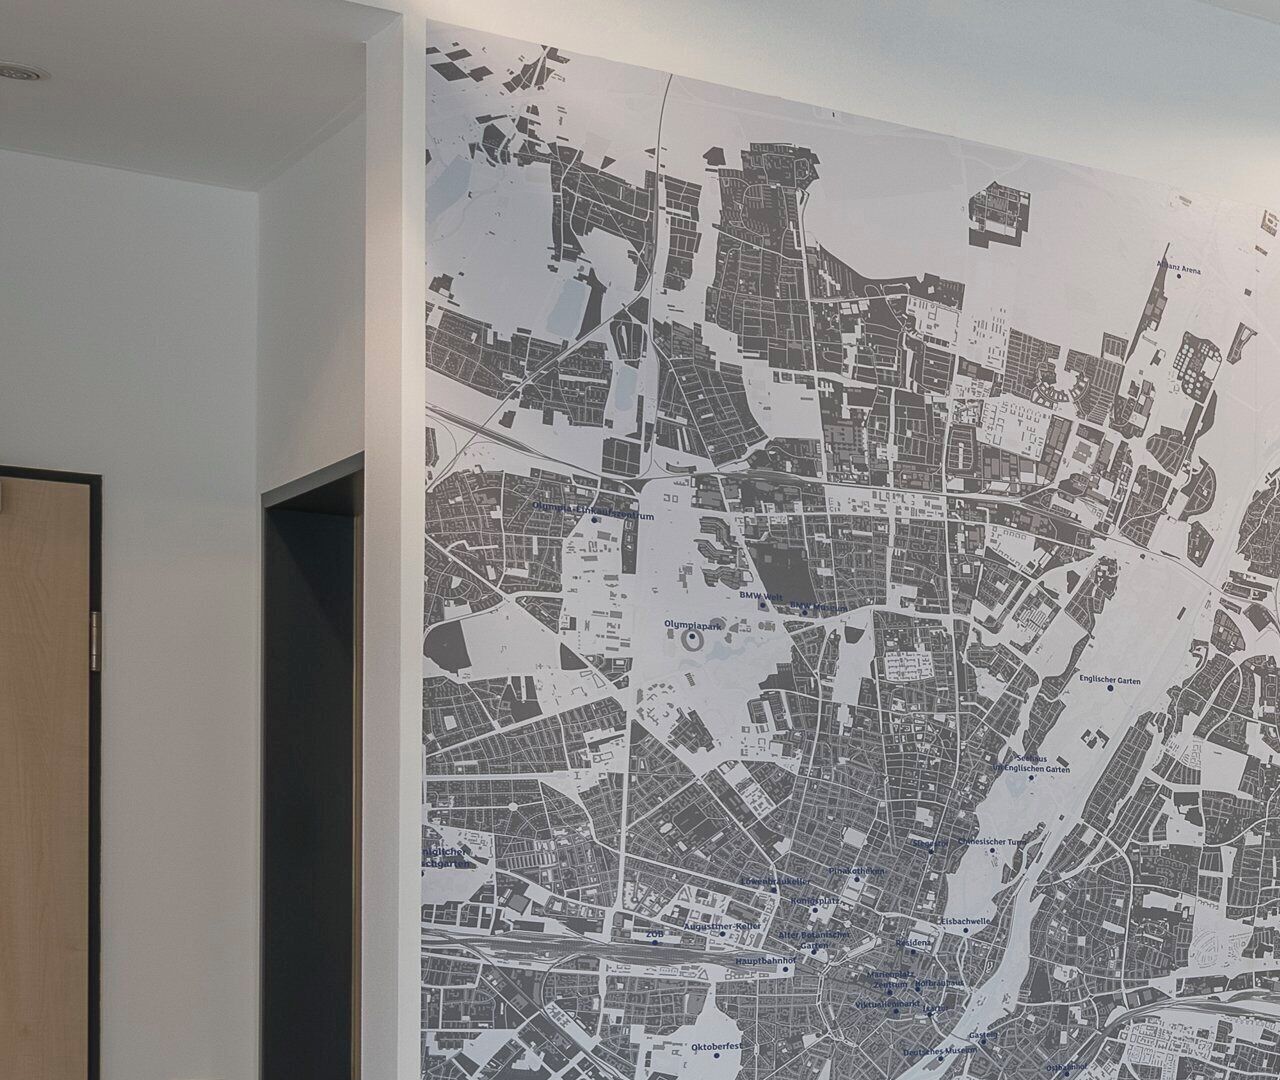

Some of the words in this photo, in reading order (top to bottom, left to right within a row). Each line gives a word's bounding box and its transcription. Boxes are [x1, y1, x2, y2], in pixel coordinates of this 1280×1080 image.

[1181, 265, 1201, 275] Arena
[739, 591, 761, 600] BMW
[763, 593, 784, 601] Welt
[664, 619, 722, 632] Olympiapark
[1079, 675, 1116, 685] Englischer
[1117, 677, 1141, 685] Garten
[1004, 764, 1044, 774] Englischen
[1045, 766, 1071, 774] Garten
[683, 922, 762, 932] Augustiner-Keller
[800, 942, 829, 950] Garten
[735, 956, 797, 966] Hauptbahnhof
[691, 1042, 744, 1051] Oktoberfest
